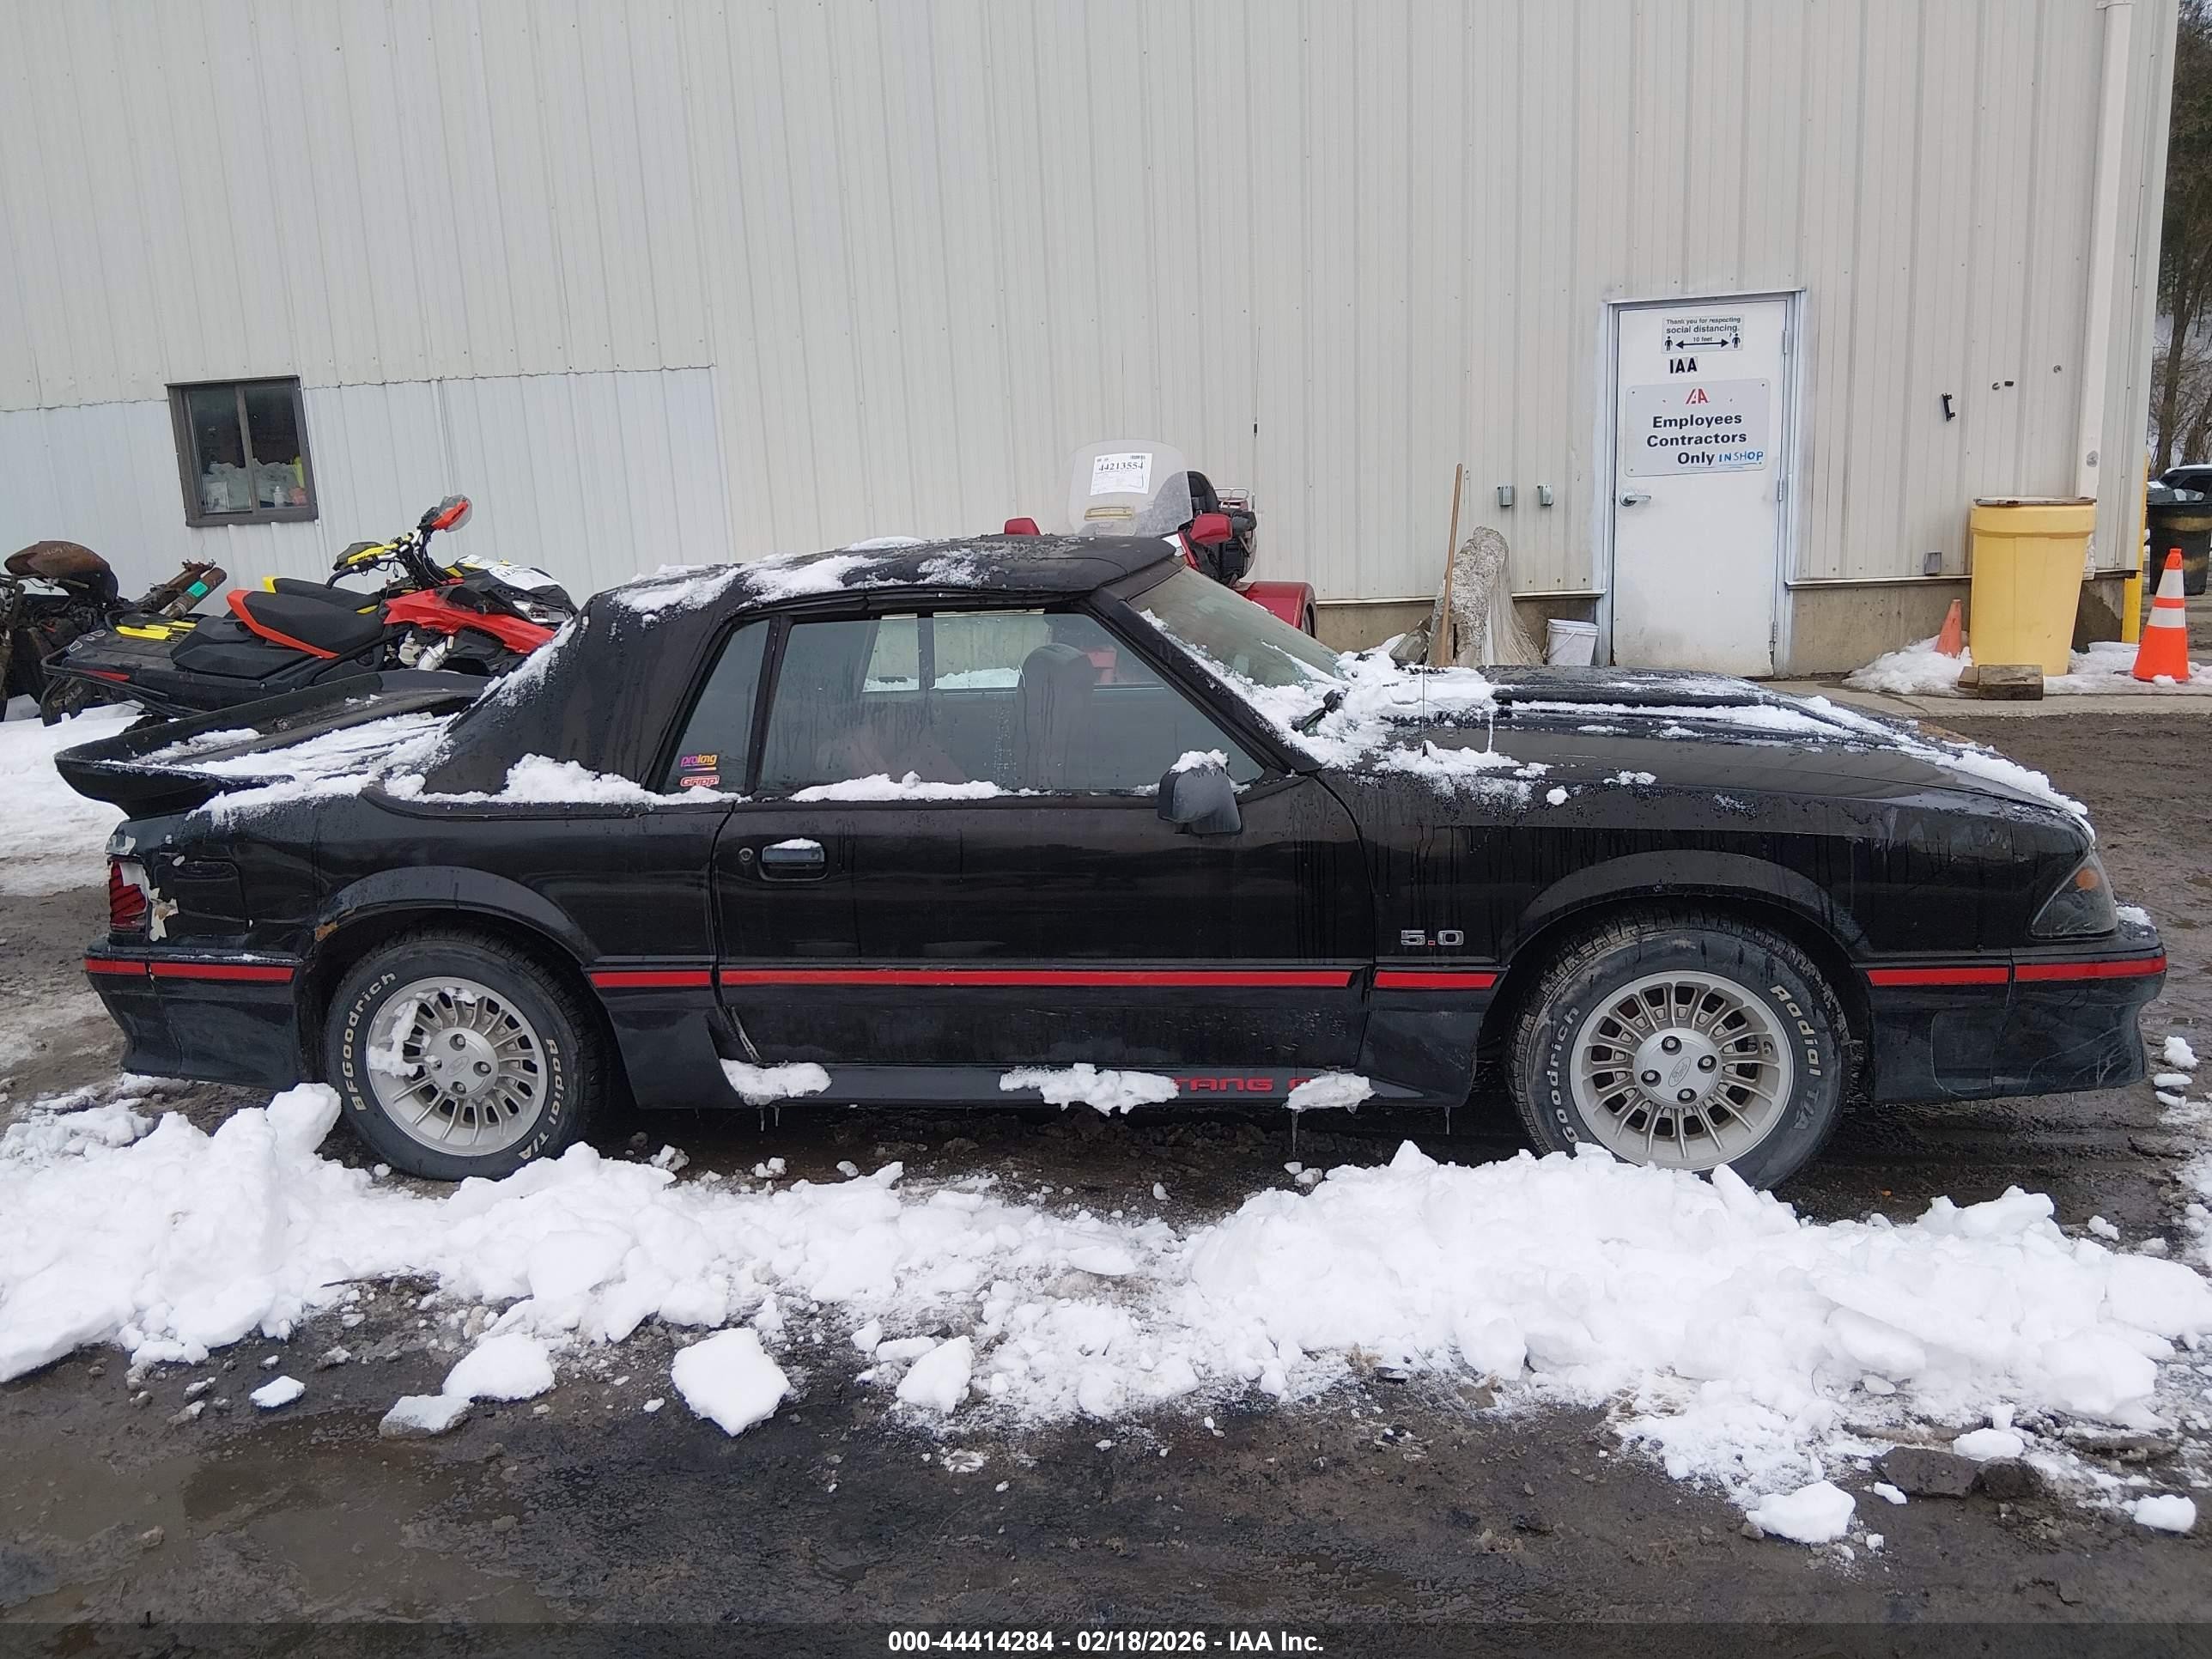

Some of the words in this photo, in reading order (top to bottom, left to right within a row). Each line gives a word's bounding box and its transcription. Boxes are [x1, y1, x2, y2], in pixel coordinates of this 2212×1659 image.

[1669, 357, 1698, 374] IAA
[1652, 414, 1742, 429] Employees
[1646, 433, 1747, 447] Contractors
[1098, 460, 1144, 471] 44213554
[1677, 451, 1716, 465] Only
[1401, 930, 1465, 946] 5.0
[1769, 984, 1821, 1077] Radial
[342, 972, 397, 1111] BFGoodrich
[545, 1038, 565, 1126] Radial
[1547, 1006, 1580, 1144] Goodrich
[1174, 1078, 1273, 1091] TANG
[518, 1131, 550, 1160] T/A
